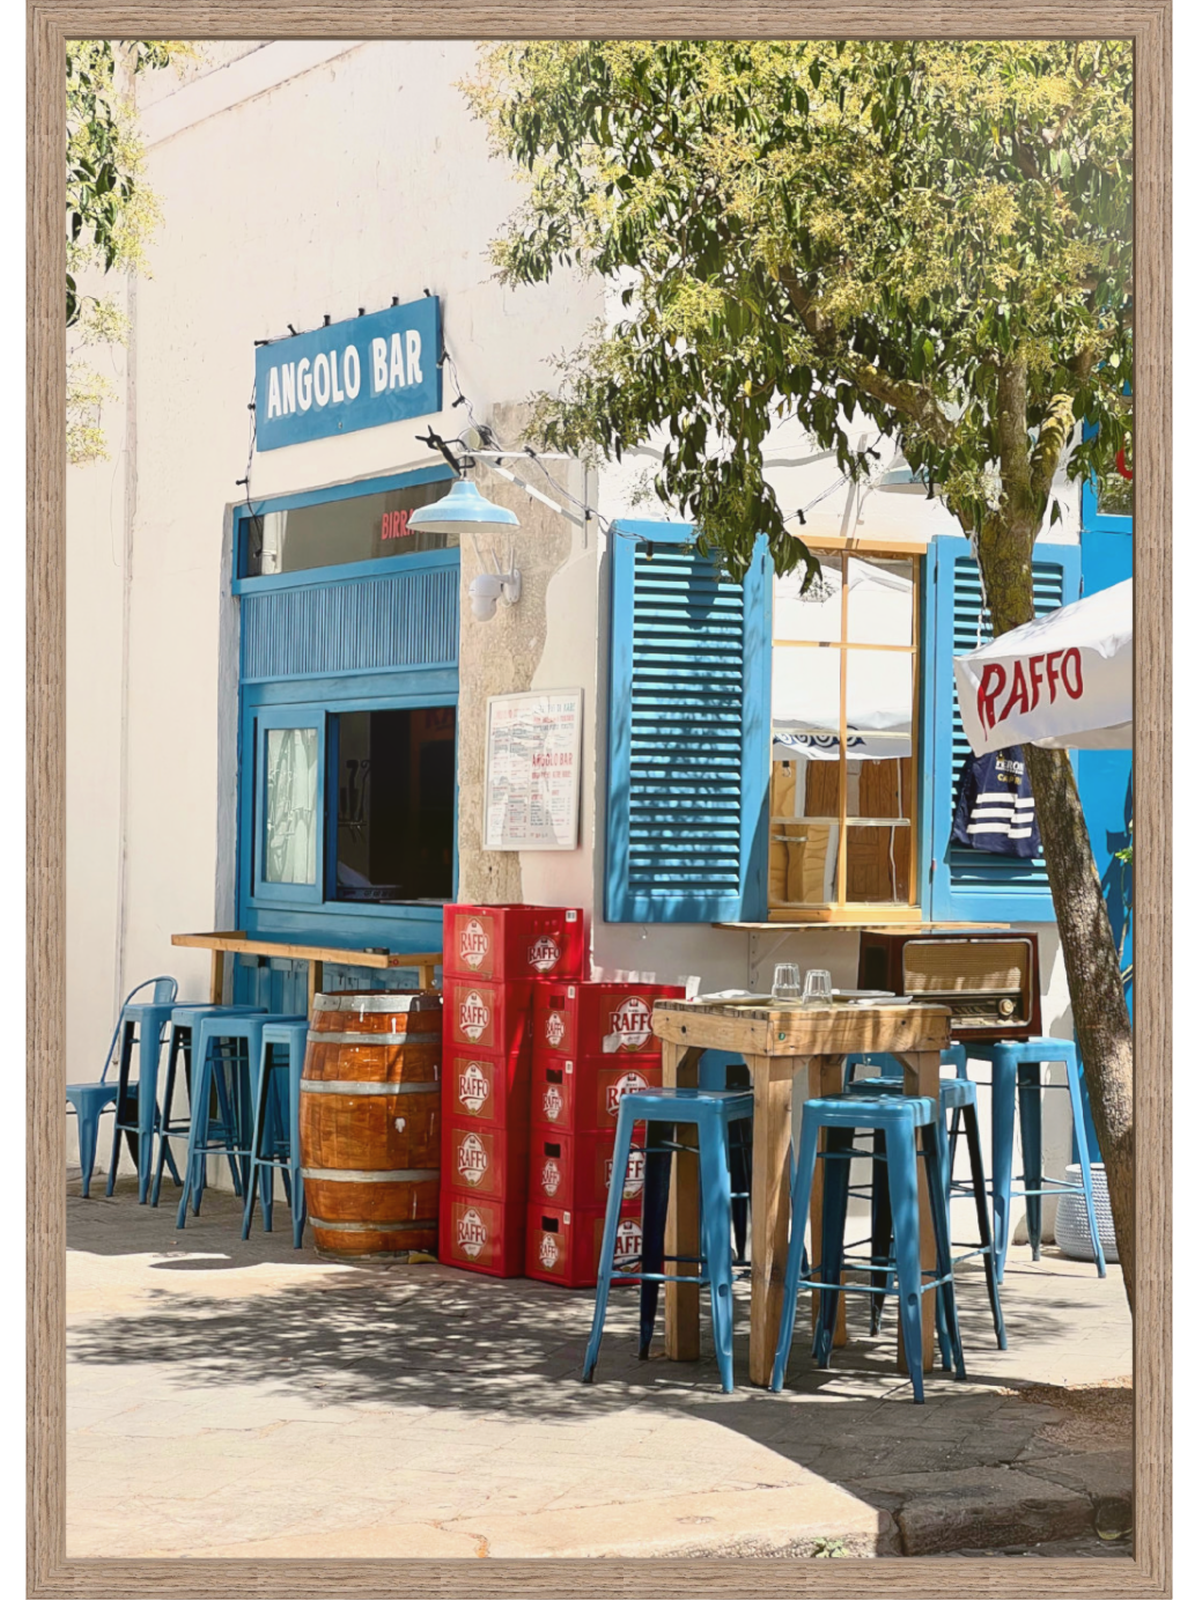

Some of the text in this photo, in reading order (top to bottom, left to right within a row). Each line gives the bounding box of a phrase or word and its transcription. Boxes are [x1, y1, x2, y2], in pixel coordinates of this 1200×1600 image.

[267, 329, 423, 419] ANGOLO BAR
[977, 647, 1084, 742] RAFFO
[460, 931, 489, 952] RAFFO
[529, 946, 560, 960] RAFFO
[460, 1004, 489, 1025] RAFFO
[459, 1076, 489, 1098] RAFFO
[458, 1146, 487, 1169] RAFFO
[457, 1219, 486, 1242] RAFFO
